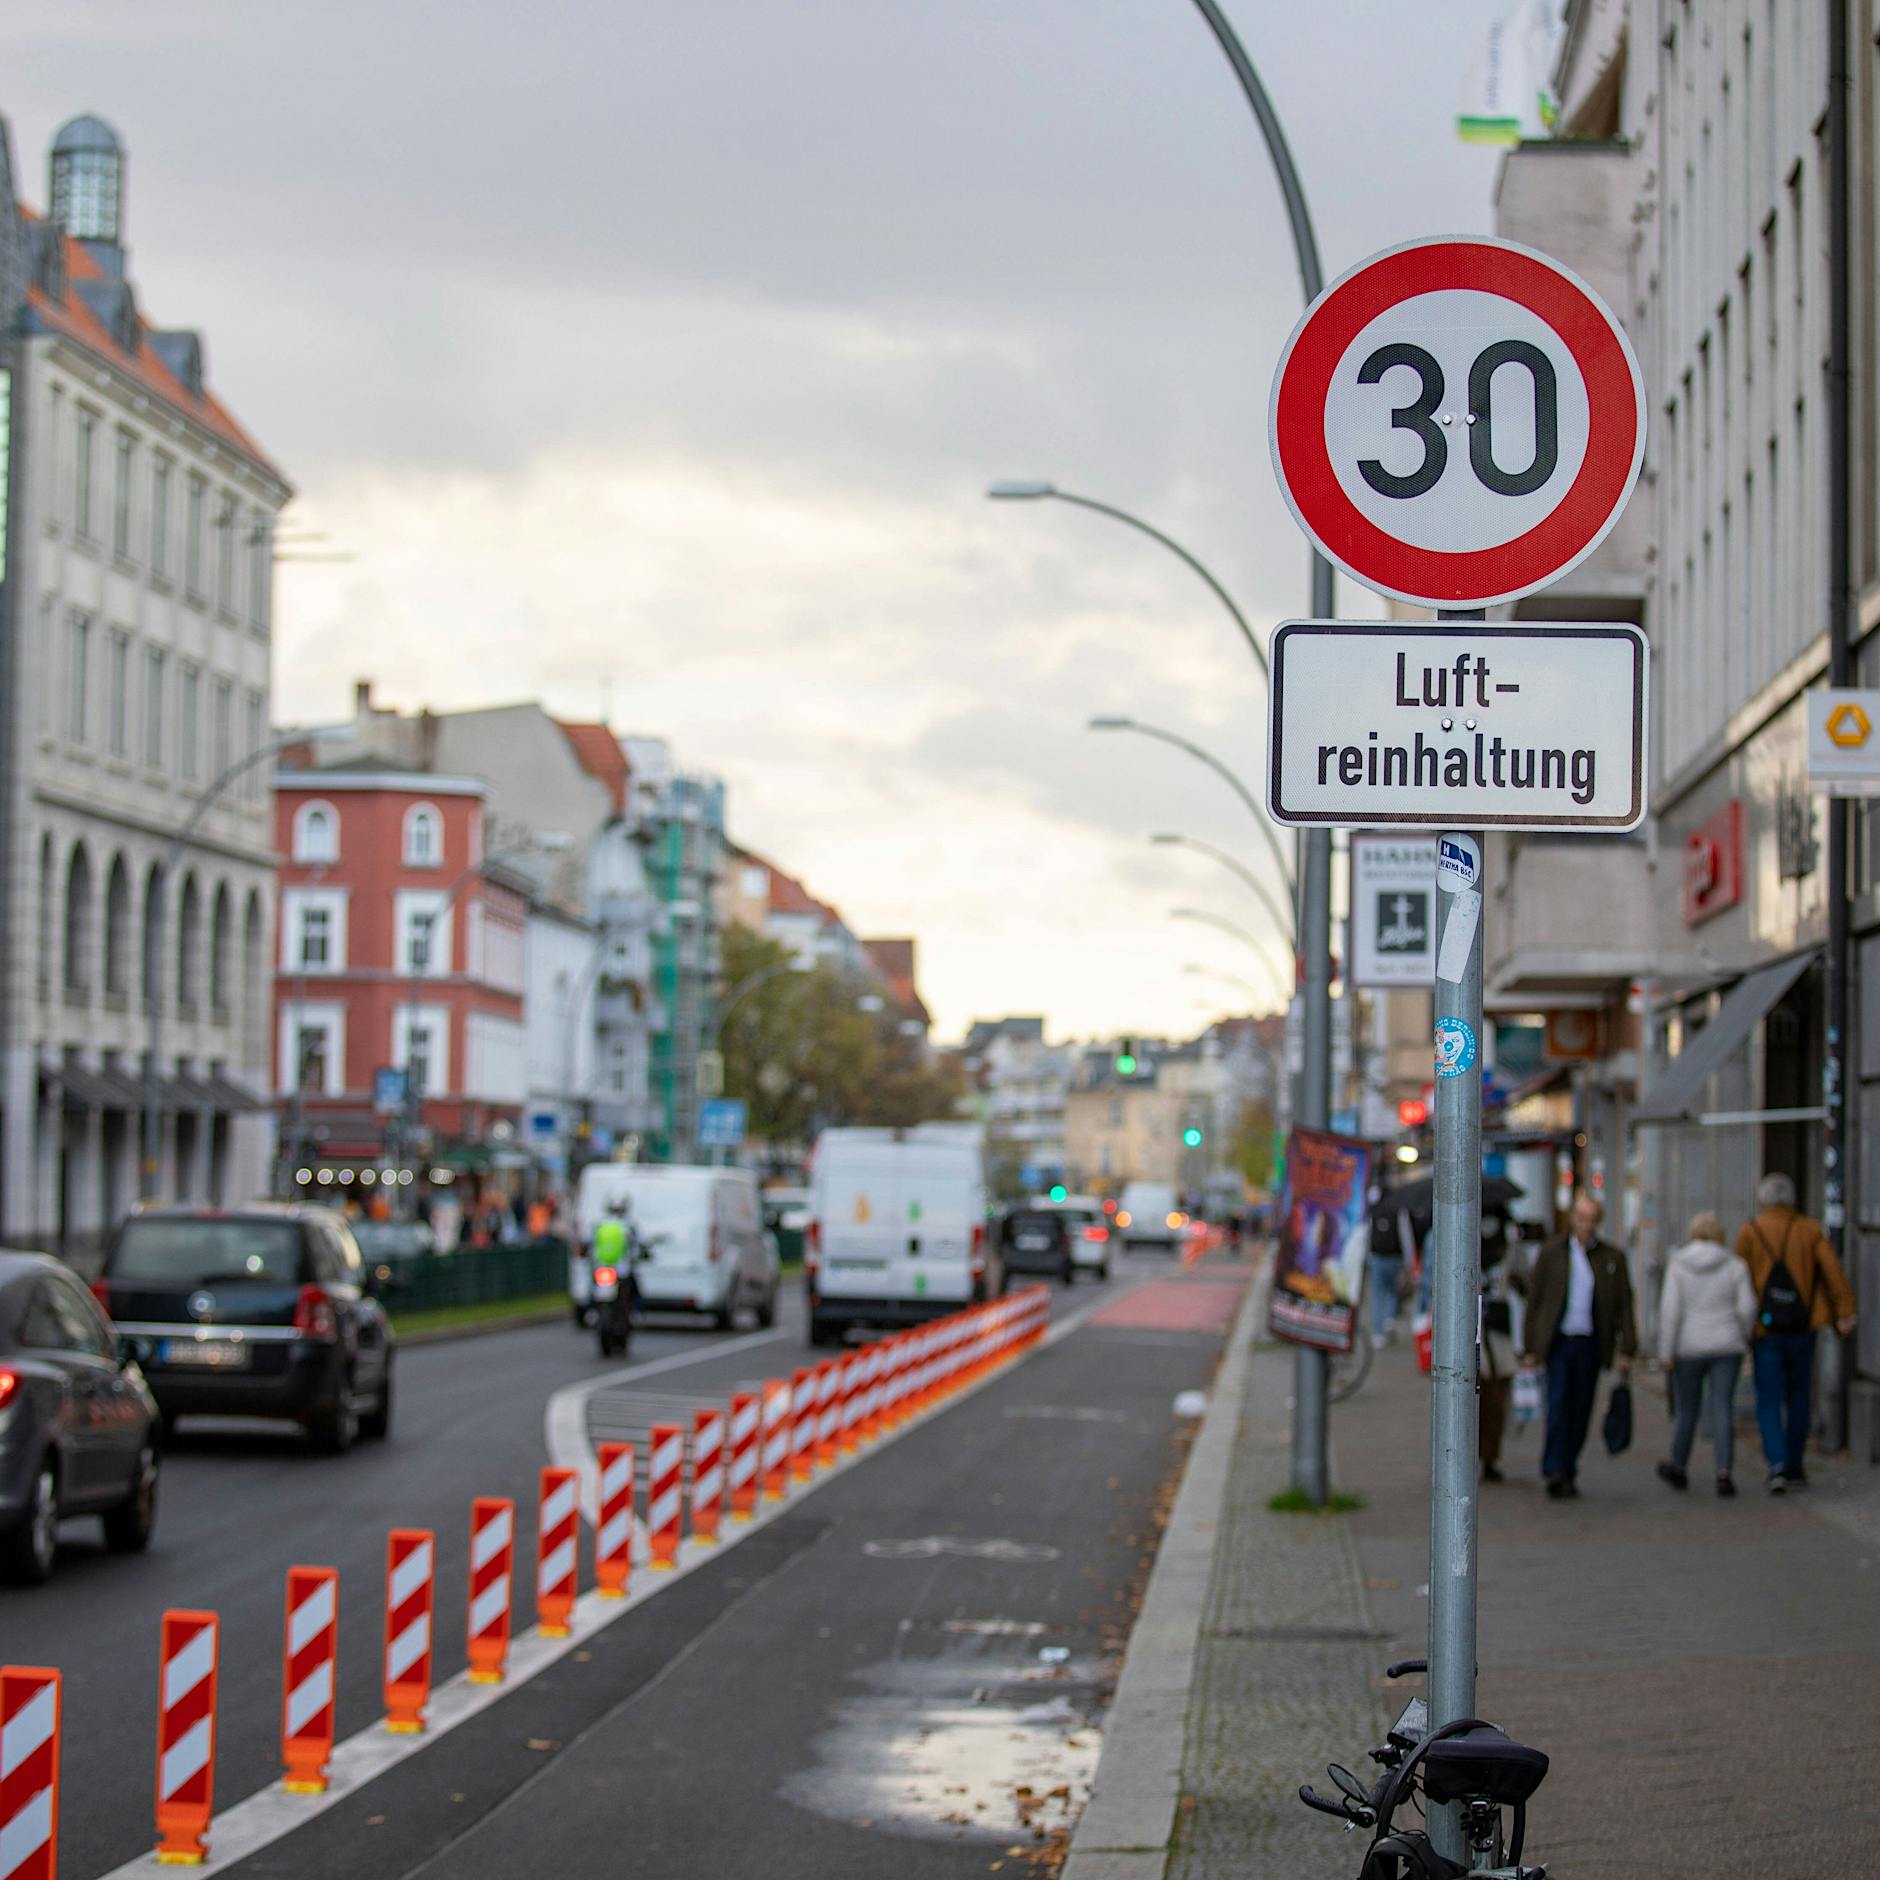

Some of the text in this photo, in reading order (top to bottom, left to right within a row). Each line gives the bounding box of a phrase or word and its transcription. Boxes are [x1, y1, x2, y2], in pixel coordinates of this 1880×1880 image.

[1356, 340, 1558, 499] 30
[1396, 652, 1519, 707] Luft-
[1318, 732, 1595, 804] reinhaltung
[1440, 859, 1472, 878] HERTHA BSC
